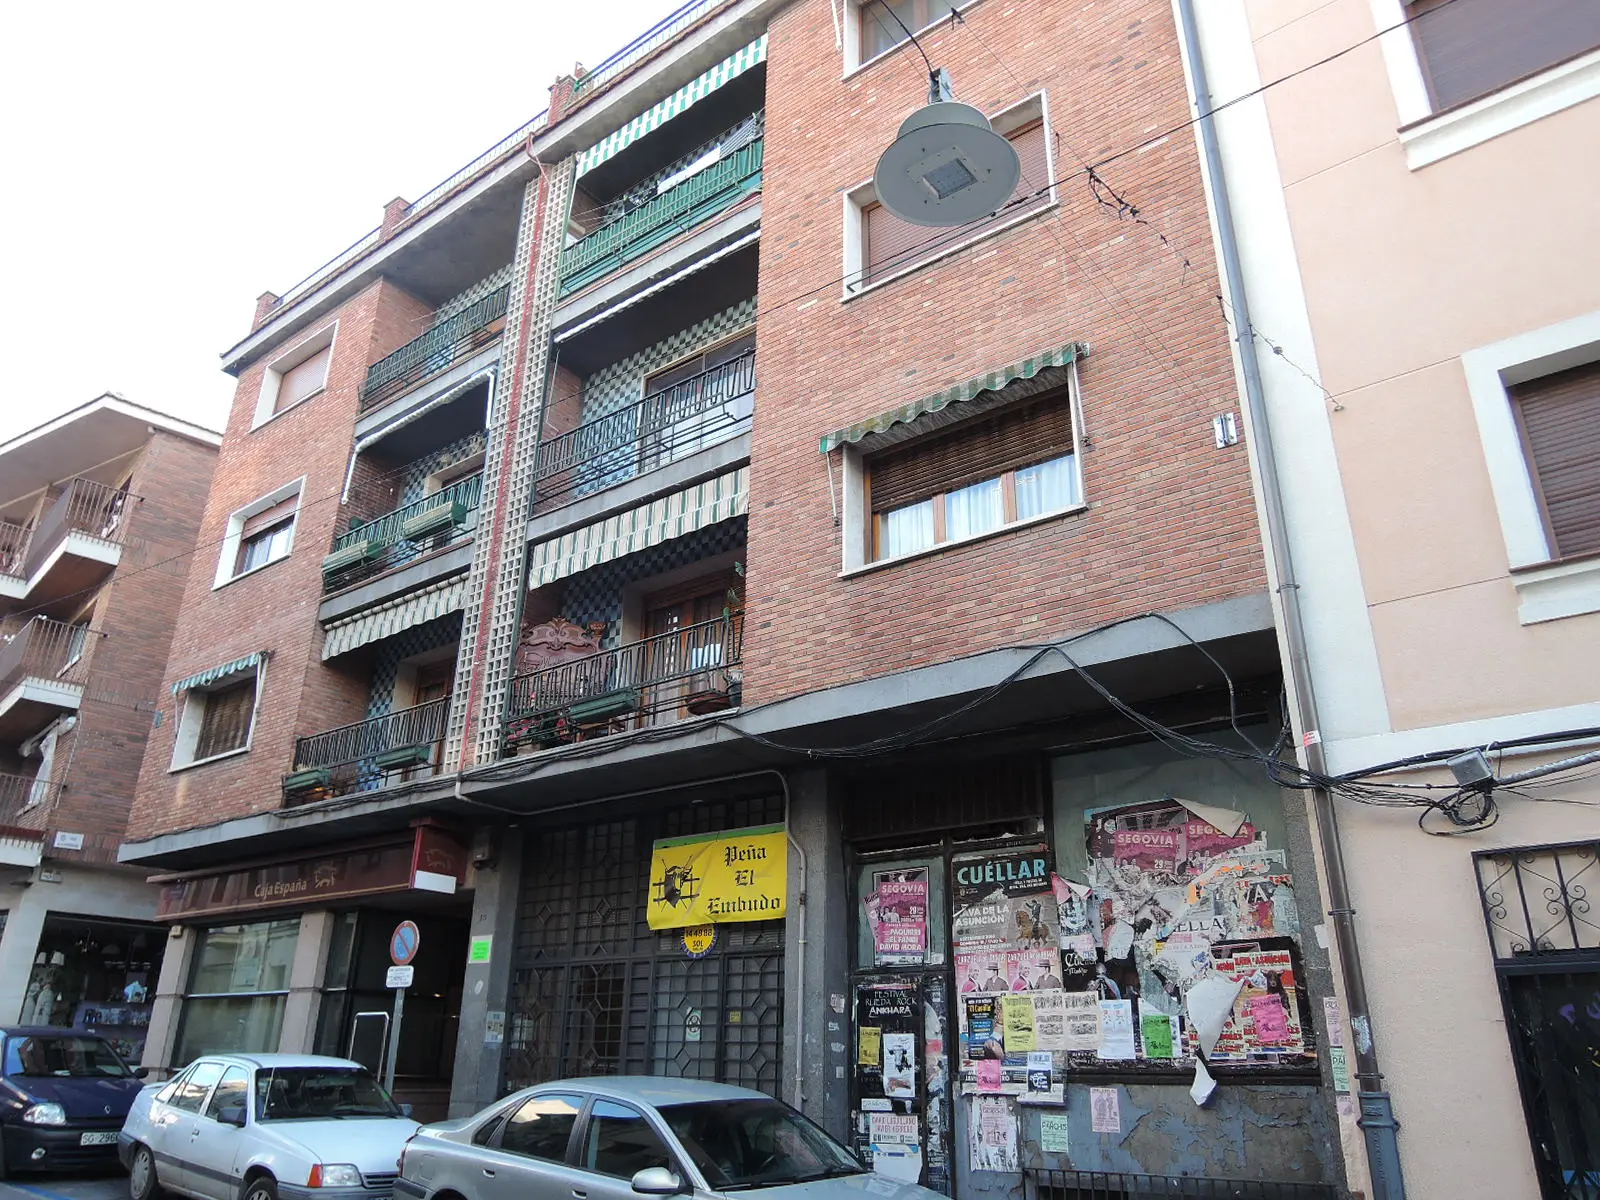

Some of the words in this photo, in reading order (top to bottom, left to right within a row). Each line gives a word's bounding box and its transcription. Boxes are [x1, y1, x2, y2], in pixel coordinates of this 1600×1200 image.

[1117, 832, 1174, 846] SEGOVIA
[725, 844, 768, 867] Peña
[735, 869, 755, 887] El
[957, 858, 1046, 886] CUÉLLAR
[254, 883, 274, 901] Caja
[274, 878, 308, 897] España
[881, 884, 925, 894] SEGOVIA
[707, 893, 781, 915] Embudo
[955, 914, 1006, 928] ASUNCIÓN
[901, 943, 922, 951] MORA
[875, 990, 908, 999] FESTIVAL
[866, 998, 891, 1006] RUEDA
[897, 998, 917, 1006] ROCK
[869, 1005, 912, 1017] ANKHARA
